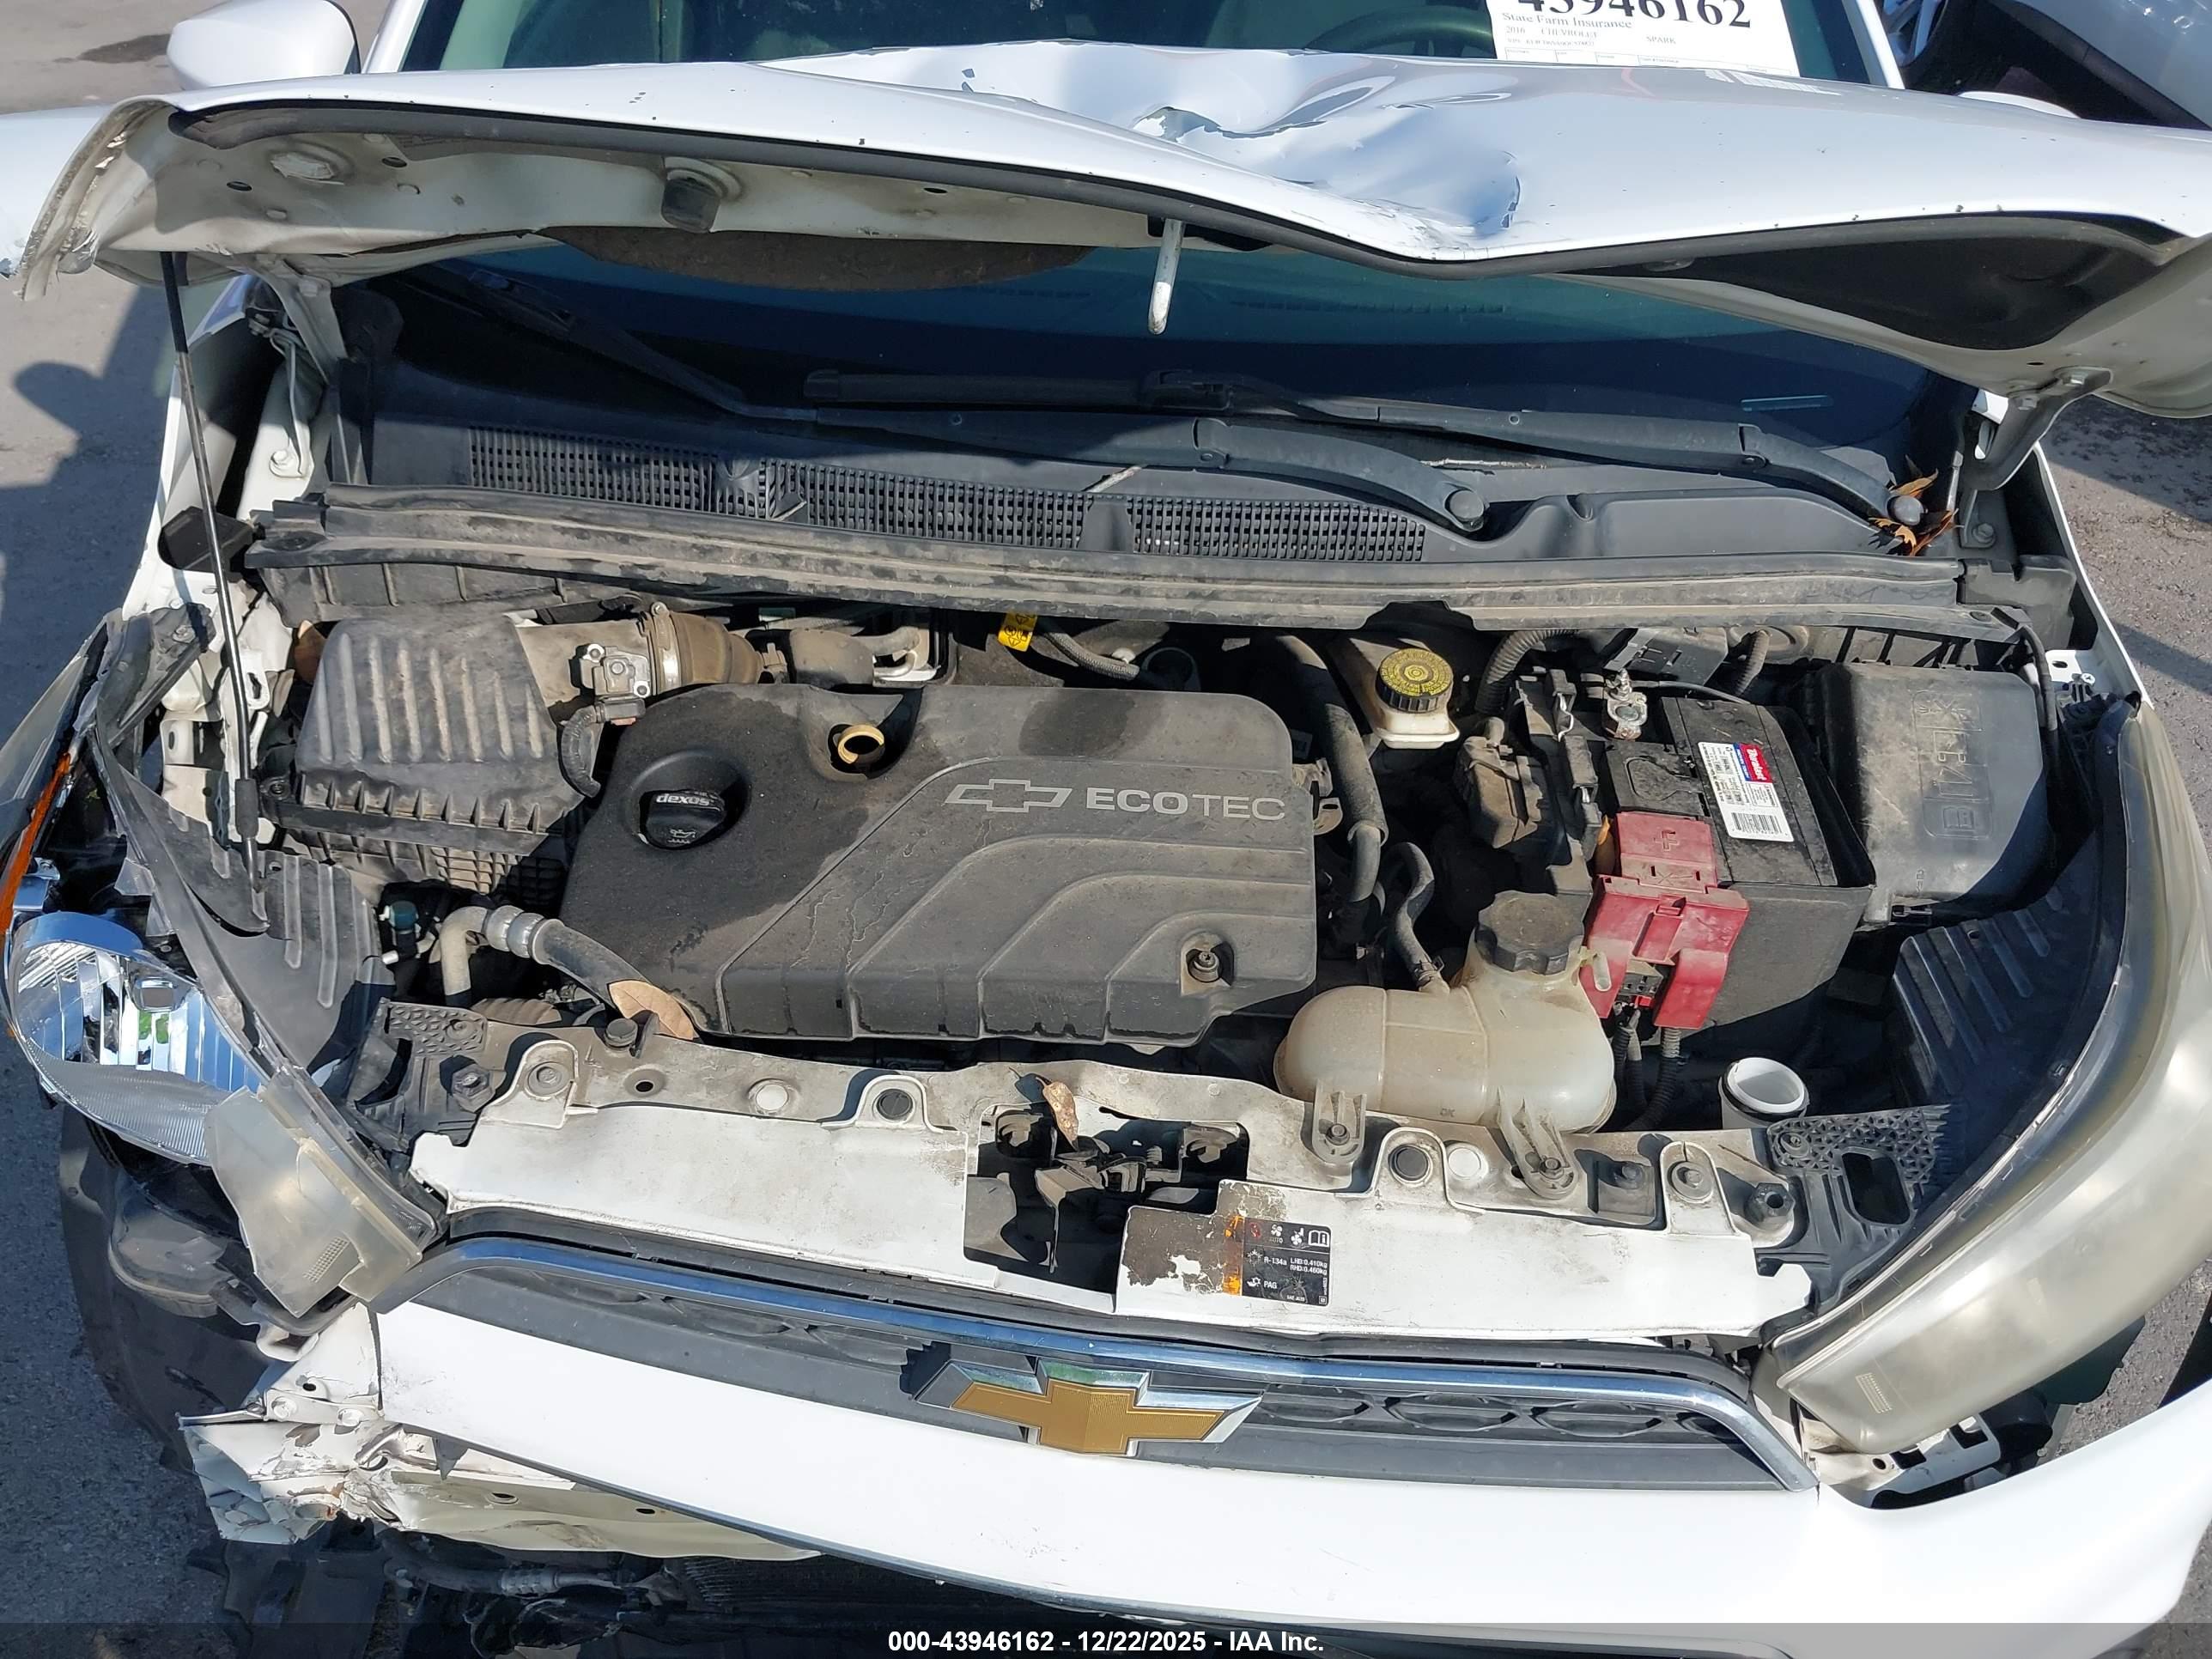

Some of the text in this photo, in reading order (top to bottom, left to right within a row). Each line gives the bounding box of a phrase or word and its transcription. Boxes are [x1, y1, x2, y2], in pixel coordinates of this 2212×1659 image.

[1503, 12, 1632, 29] State Farm Insurance
[1646, 36, 1676, 45] SPARK
[1746, 748, 1767, 781] Duralast
[656, 793, 710, 806] dexos
[1086, 787, 1286, 821] ECOTEC
[1263, 1256, 1288, 1266] R-134a
[1263, 1280, 1278, 1290] PAG
